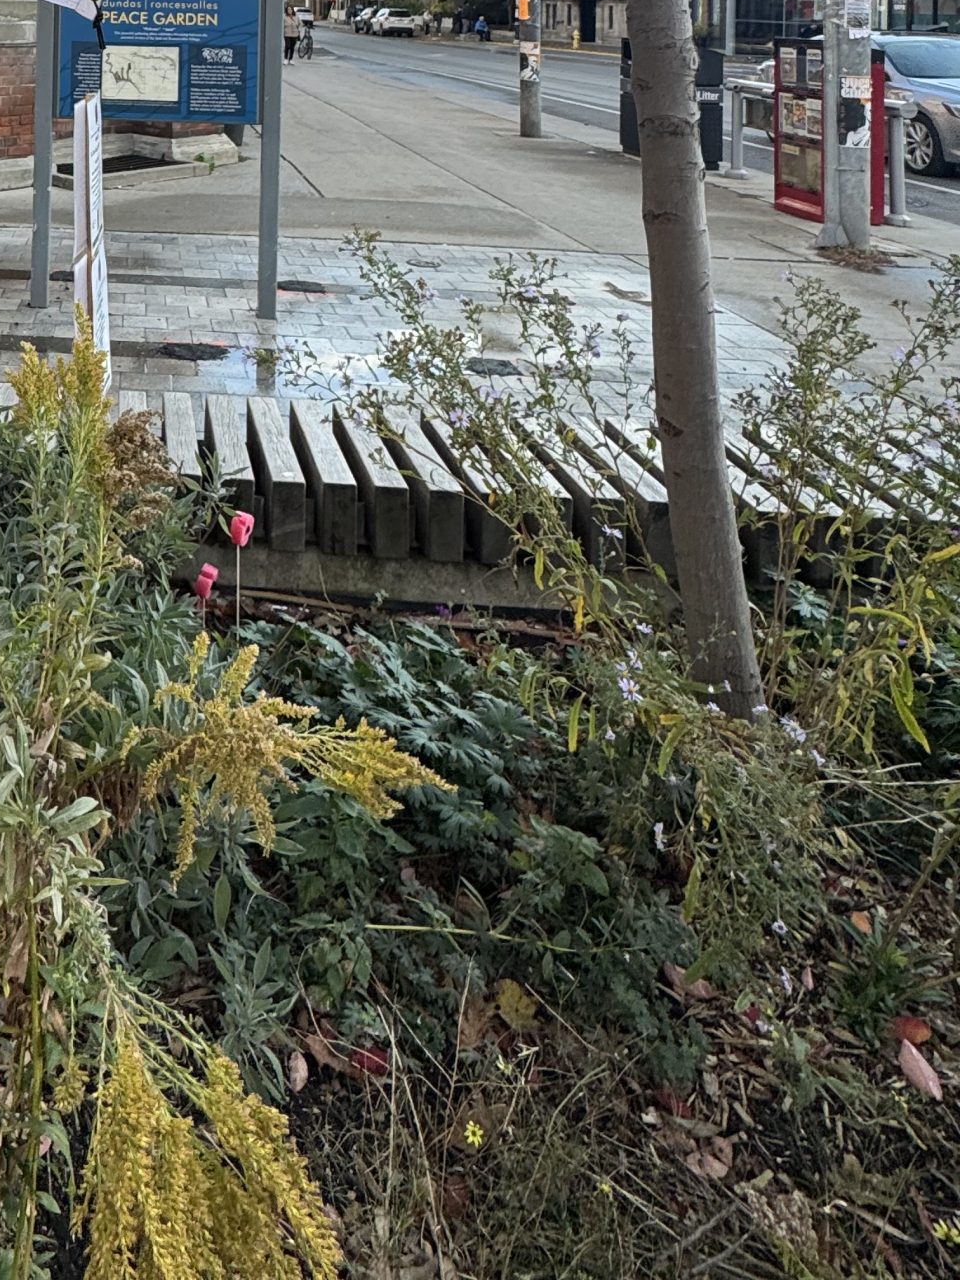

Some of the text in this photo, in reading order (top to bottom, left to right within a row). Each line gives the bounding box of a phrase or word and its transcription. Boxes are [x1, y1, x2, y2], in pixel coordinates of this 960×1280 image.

[150, 0, 218, 10] roncesvalles
[102, 10, 218, 26] PEACE GARDEN
[697, 90, 719, 100] Litter
